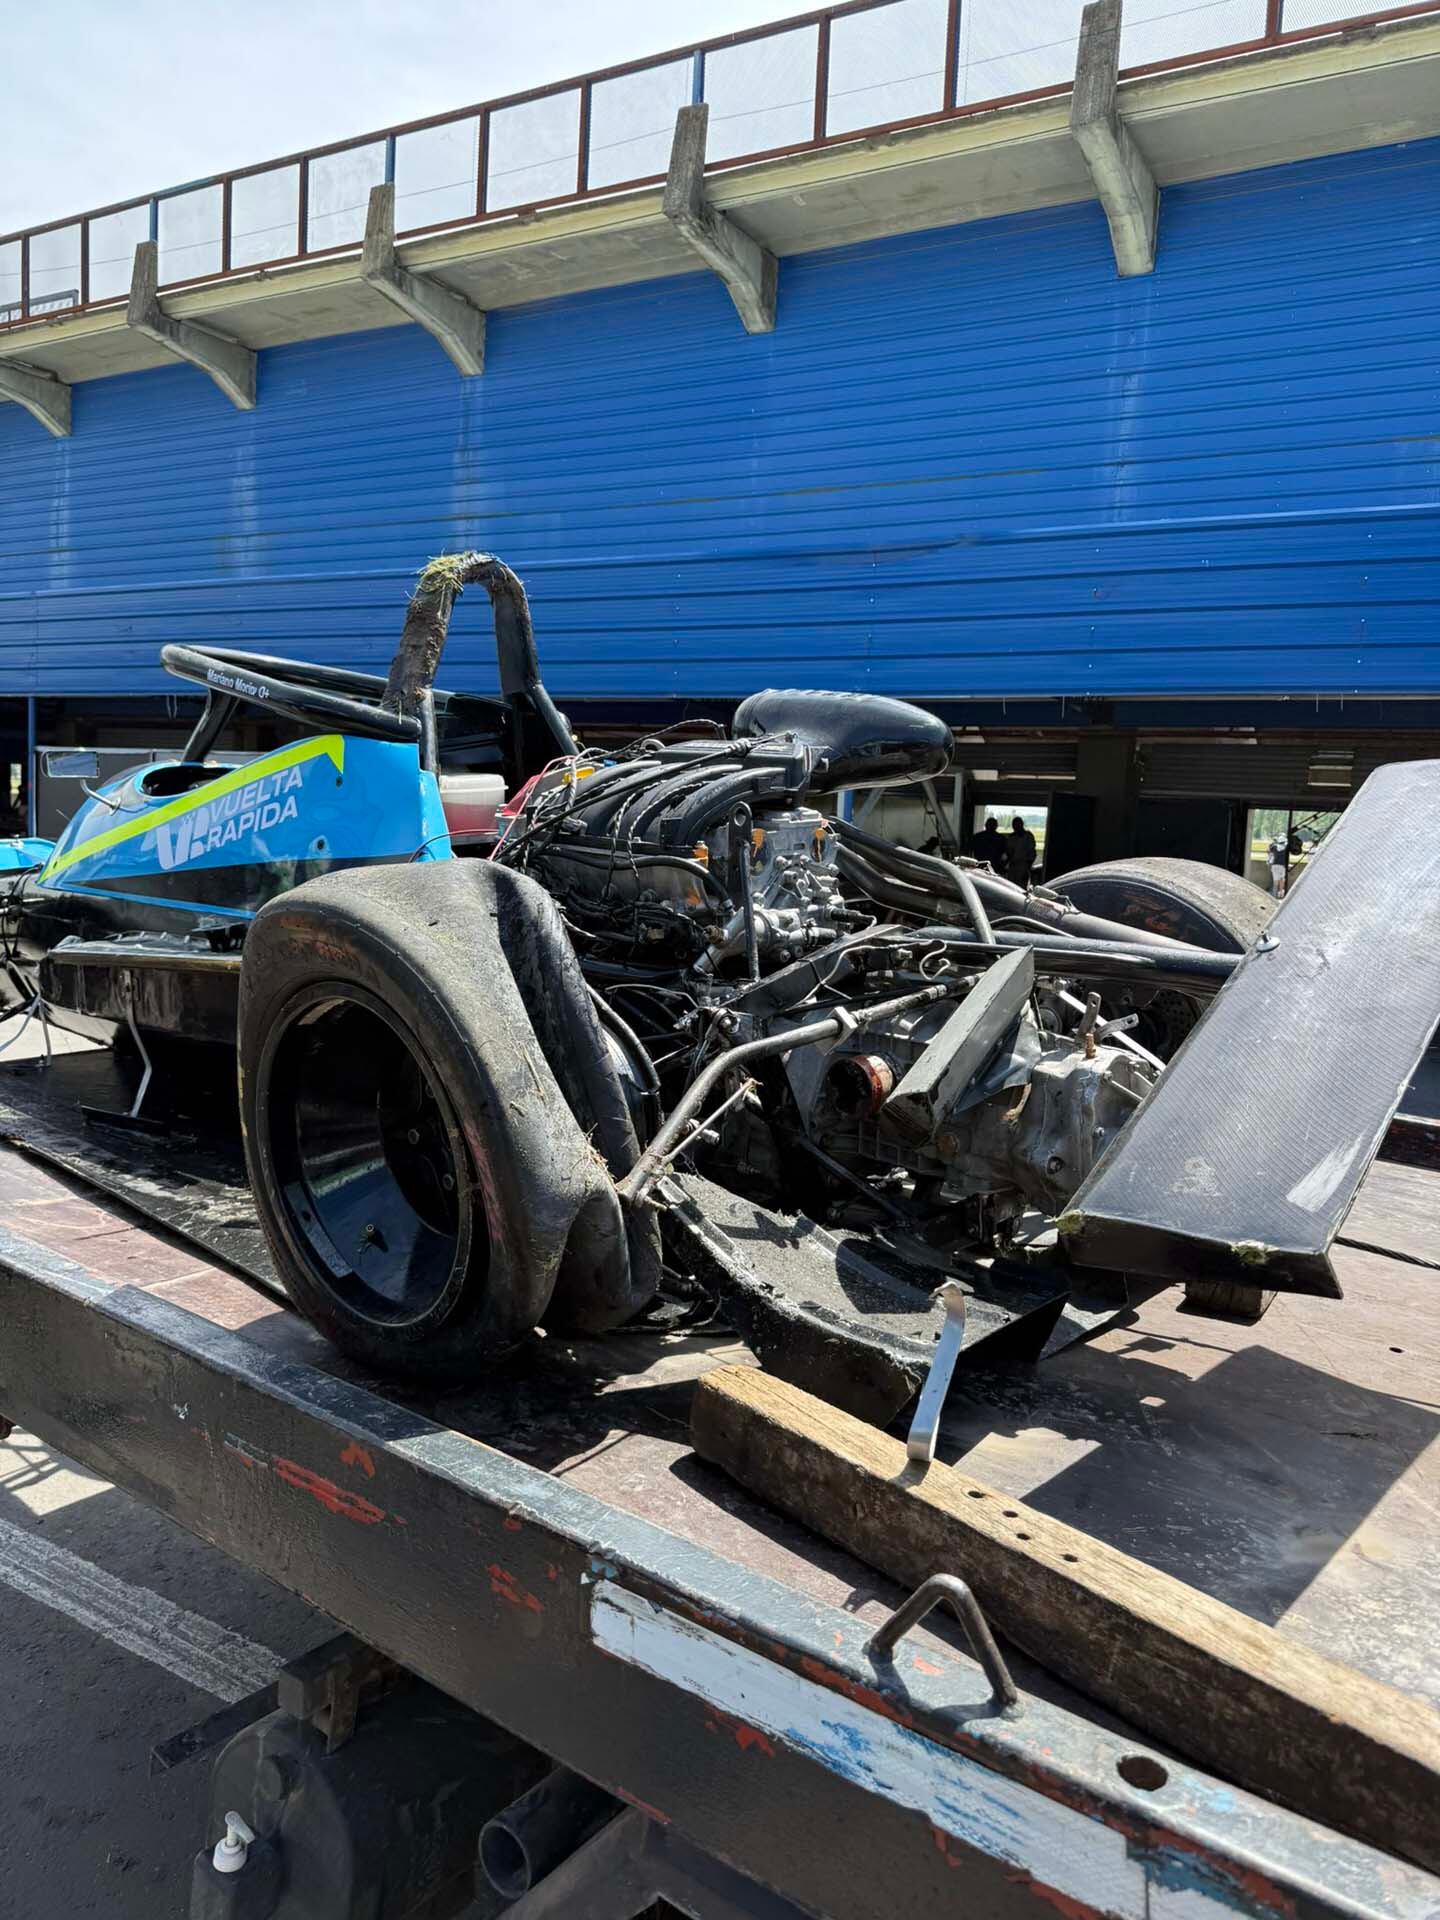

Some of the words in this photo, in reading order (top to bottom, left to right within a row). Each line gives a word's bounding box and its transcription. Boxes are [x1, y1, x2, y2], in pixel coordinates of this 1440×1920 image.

[207, 669, 234, 688] Mariano
[211, 766, 303, 823] VUELTA
[206, 795, 298, 852] RAPIDA
